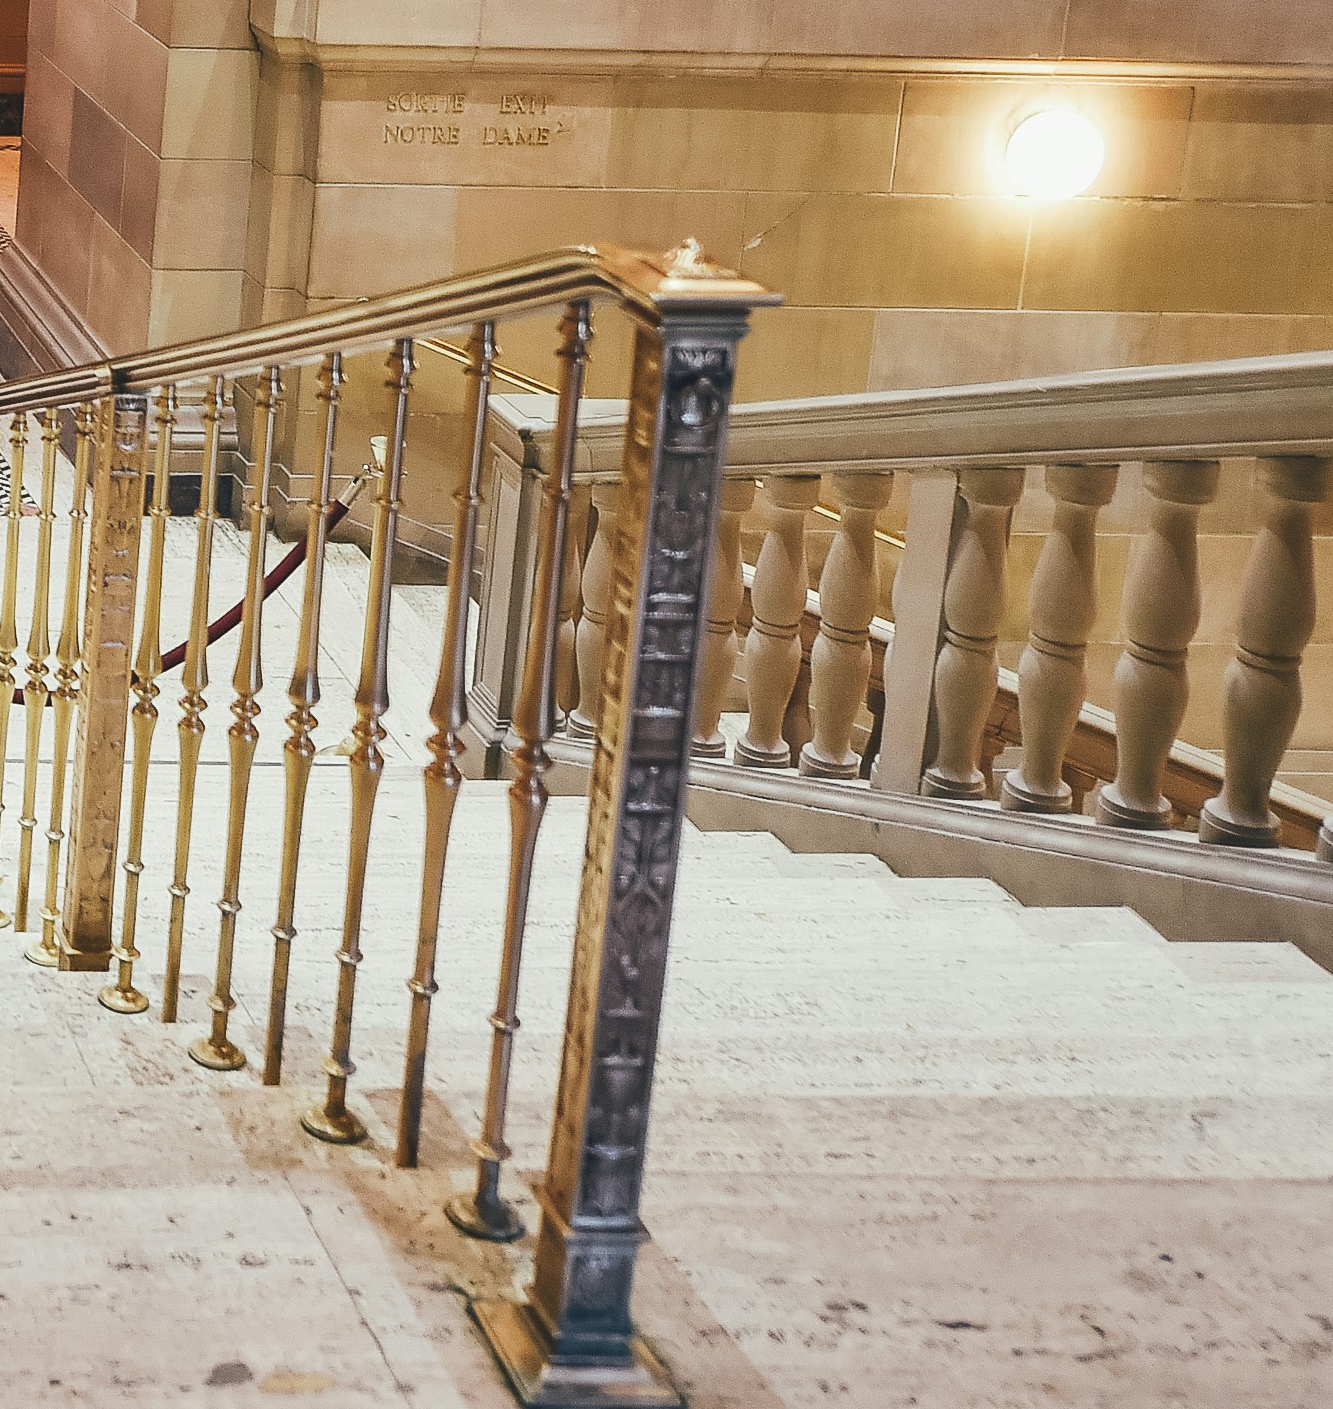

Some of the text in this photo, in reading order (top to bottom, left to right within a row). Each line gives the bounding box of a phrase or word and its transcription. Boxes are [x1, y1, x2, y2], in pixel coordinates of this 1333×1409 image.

[386, 92, 550, 115] SORTIE EXIT
[382, 123, 551, 146] NOTRE DAME
